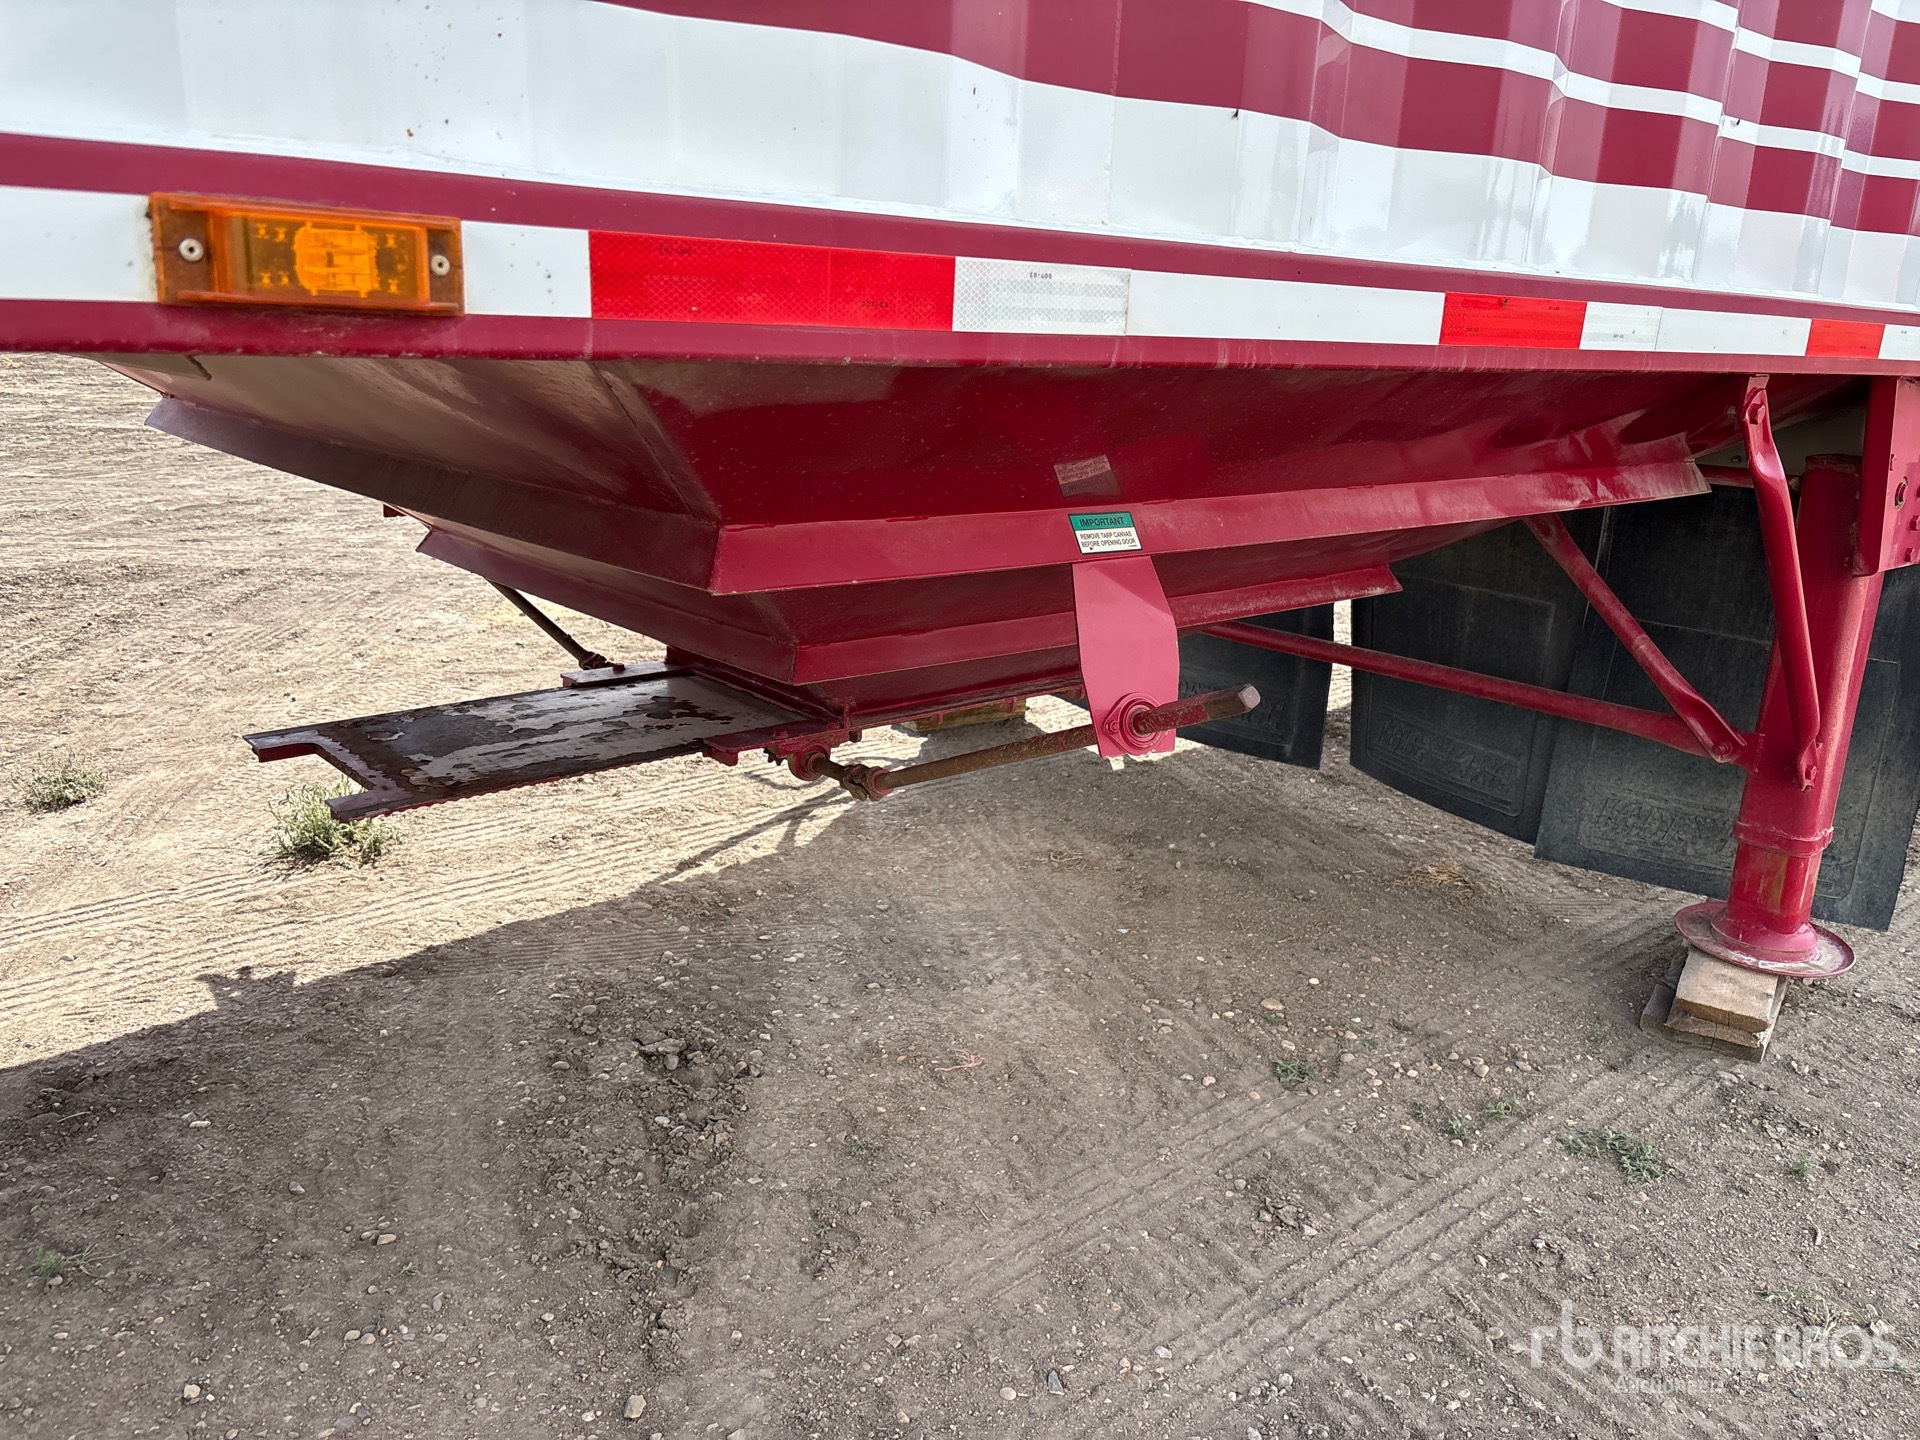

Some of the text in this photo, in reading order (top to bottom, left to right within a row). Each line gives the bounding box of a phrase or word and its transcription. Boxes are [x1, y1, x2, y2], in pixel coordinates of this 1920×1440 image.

[1079, 516, 1125, 527] IMPORTANT
[1080, 530, 1132, 540] REMOVE TARP CANVAS
[1081, 540, 1101, 548] BEFORE
[1100, 539, 1122, 547] OPENING
